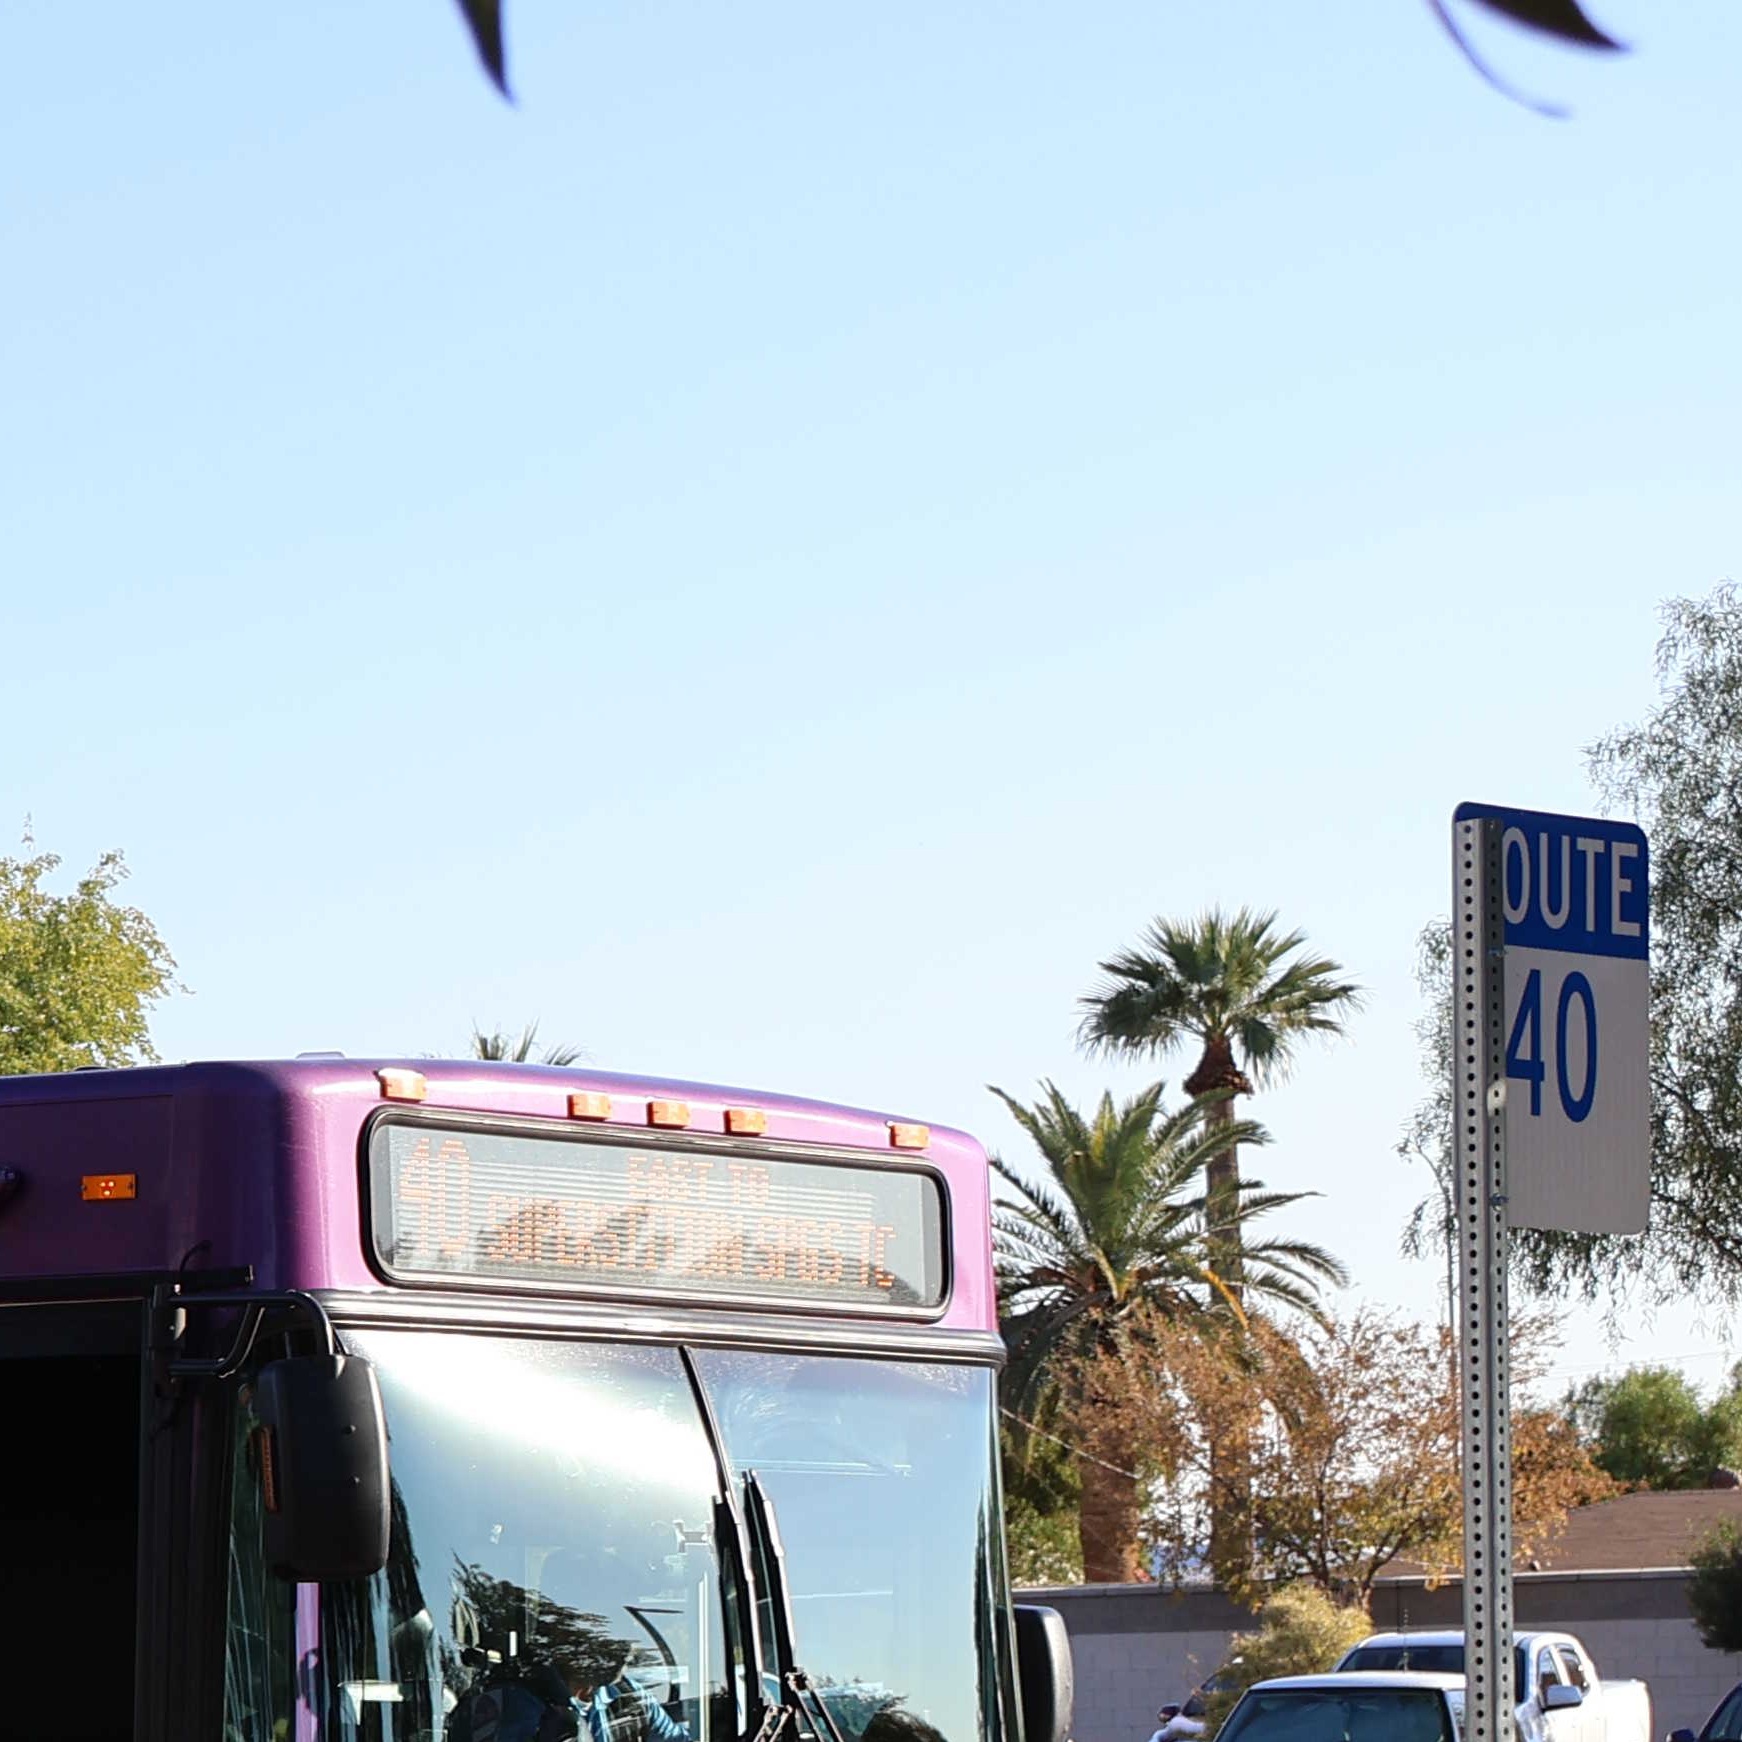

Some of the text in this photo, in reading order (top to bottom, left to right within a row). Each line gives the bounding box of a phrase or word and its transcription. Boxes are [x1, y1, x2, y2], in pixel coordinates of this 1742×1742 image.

[1502, 827, 1641, 937] OUTE
[1505, 968, 1597, 1123] 40
[398, 1137, 470, 1257] 40
[628, 1155, 770, 1207] EAST TO
